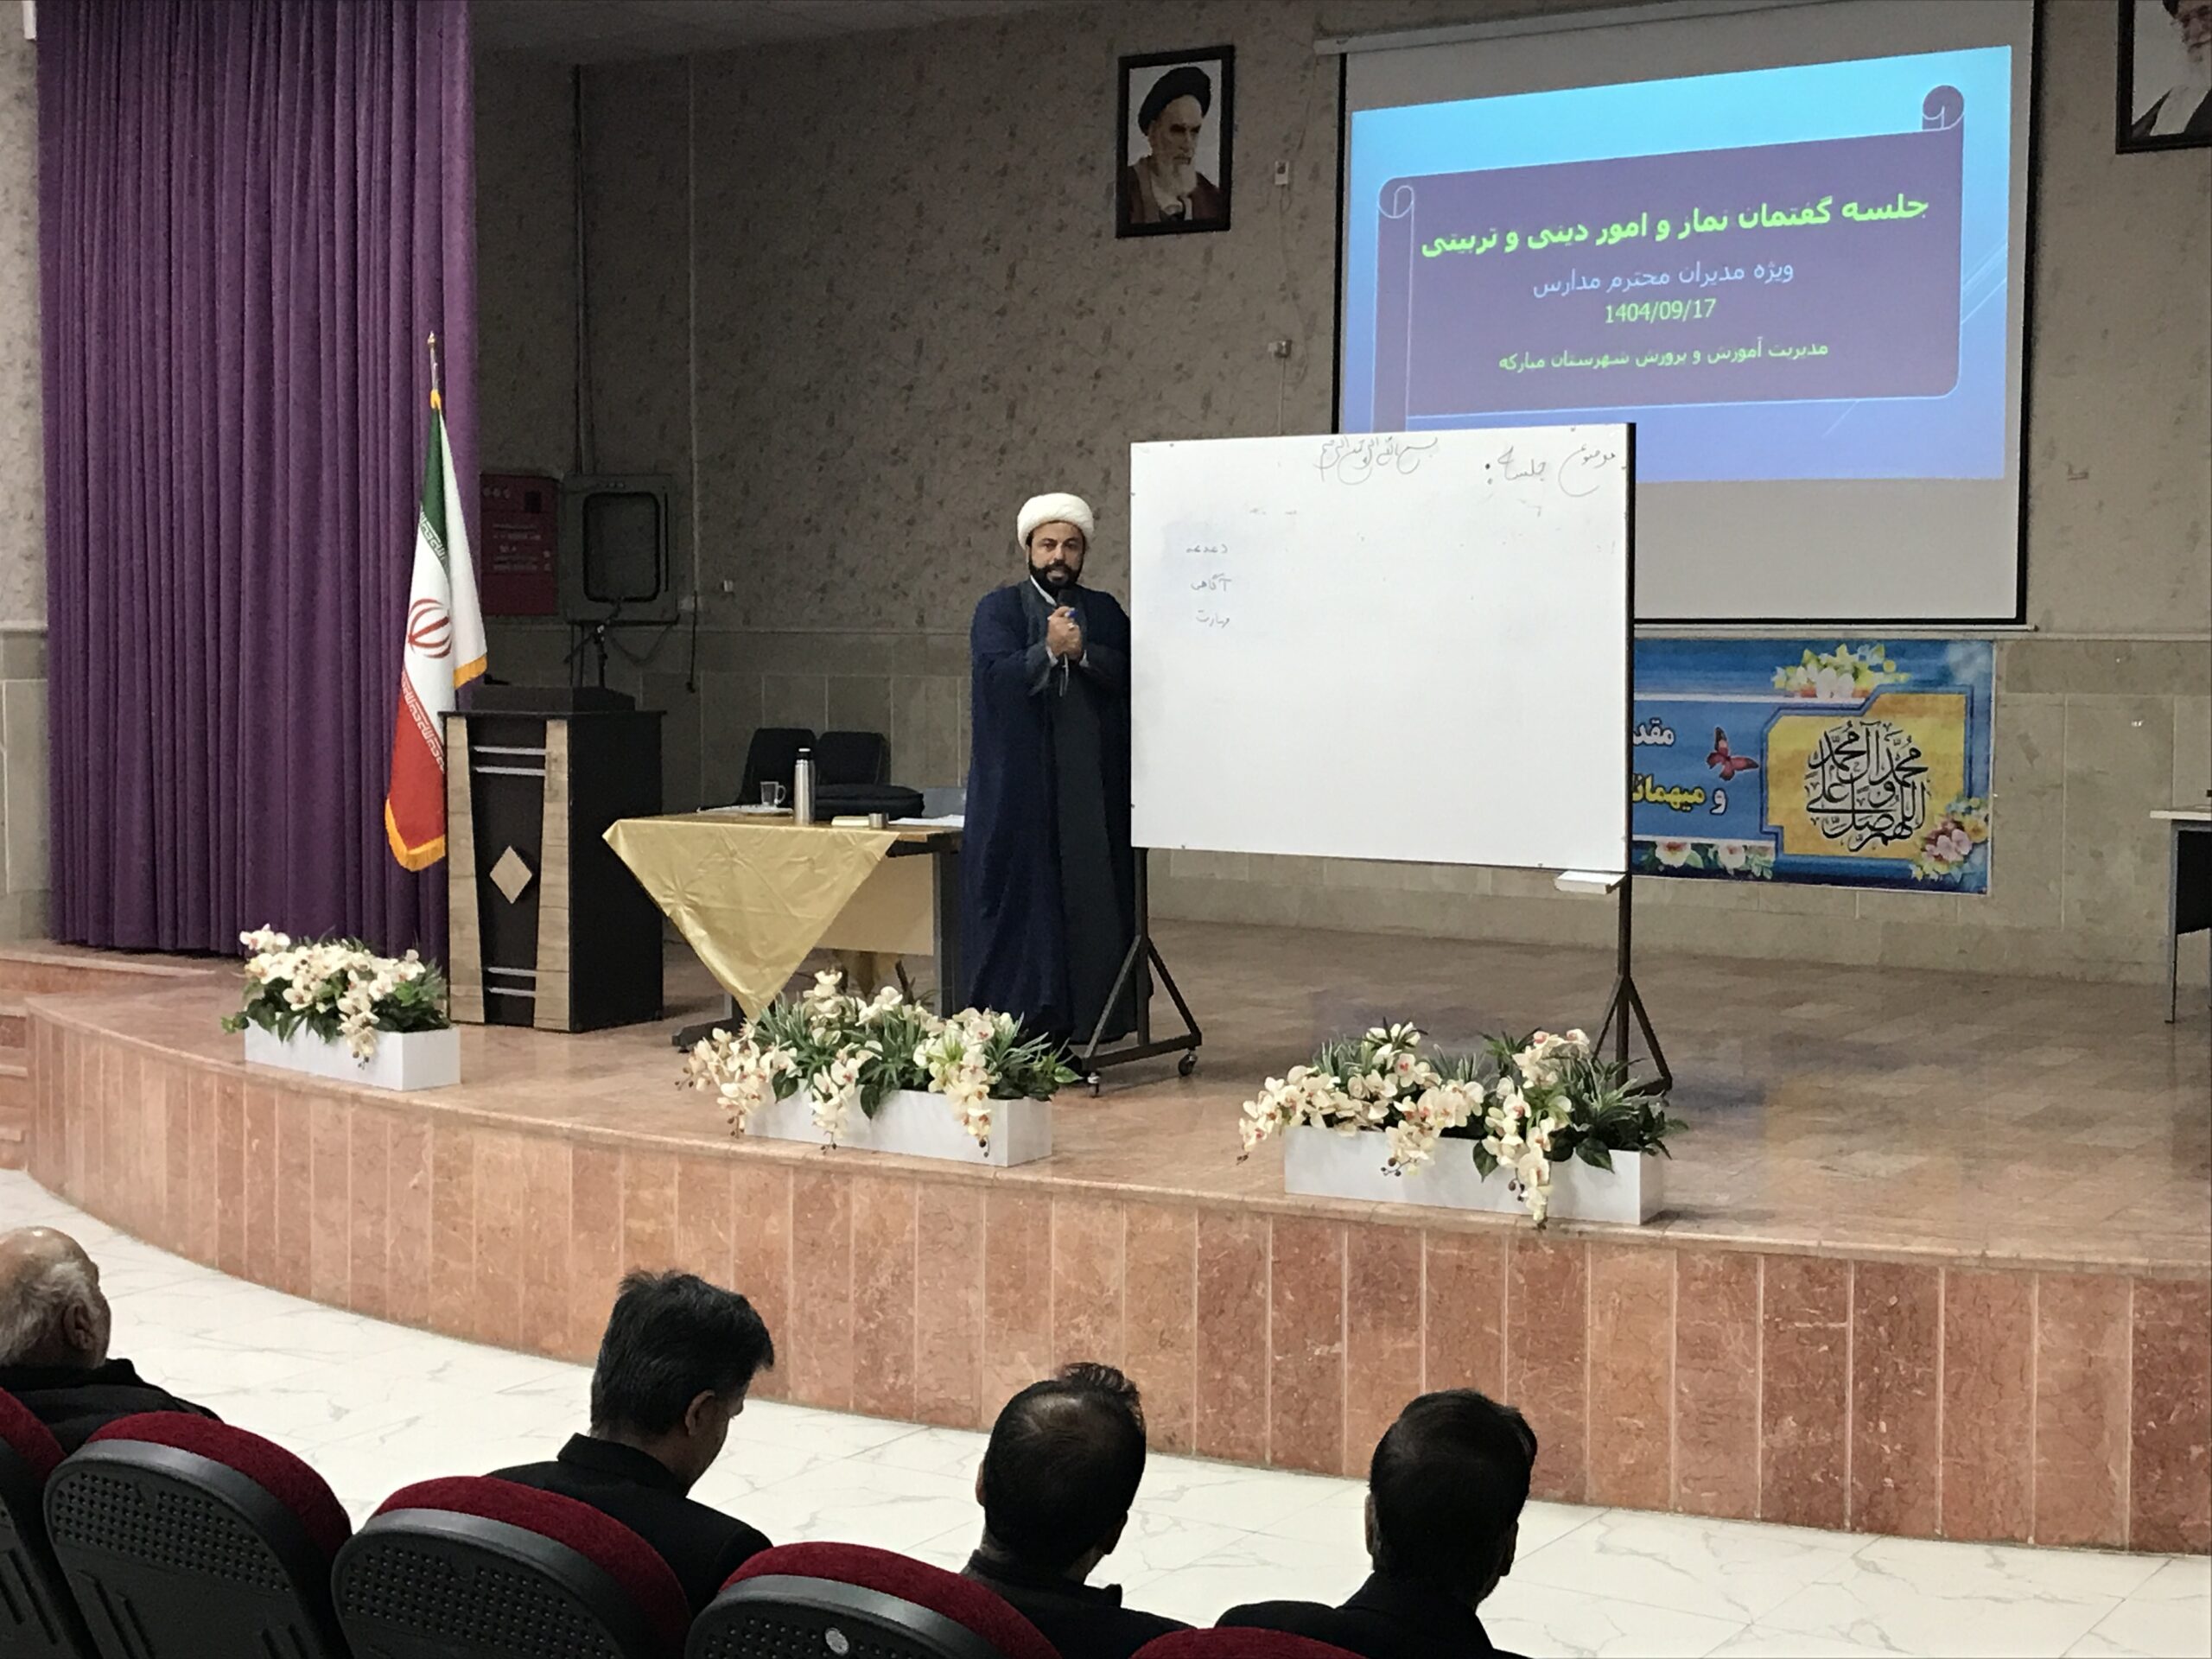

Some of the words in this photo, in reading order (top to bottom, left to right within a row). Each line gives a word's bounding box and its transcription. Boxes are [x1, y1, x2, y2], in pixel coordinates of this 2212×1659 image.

[1738, 195, 1833, 229] گفتمان
[1841, 194, 1929, 221] جلسه
[1596, 212, 1648, 245] امور
[1655, 219, 1670, 241] و
[1677, 207, 1728, 239] نماز
[1421, 228, 1498, 257] تربیتی
[1503, 231, 1519, 252] و
[1527, 223, 1589, 249] دینی
[1533, 269, 1600, 298] مدارس
[1606, 272, 1670, 293] محترم
[1679, 261, 1745, 288] مدیران
[1753, 261, 1794, 283] ویژه
[1605, 298, 1716, 323] 1404/09/17
[1551, 349, 1629, 370] شهرستان
[1636, 347, 1688, 368] پرورش
[1692, 349, 1700, 365] و
[1707, 336, 1763, 364] آموزش
[1768, 340, 1828, 358] مدیریت
[1498, 352, 1545, 373] مبارکه
[1709, 788, 1727, 814] و
